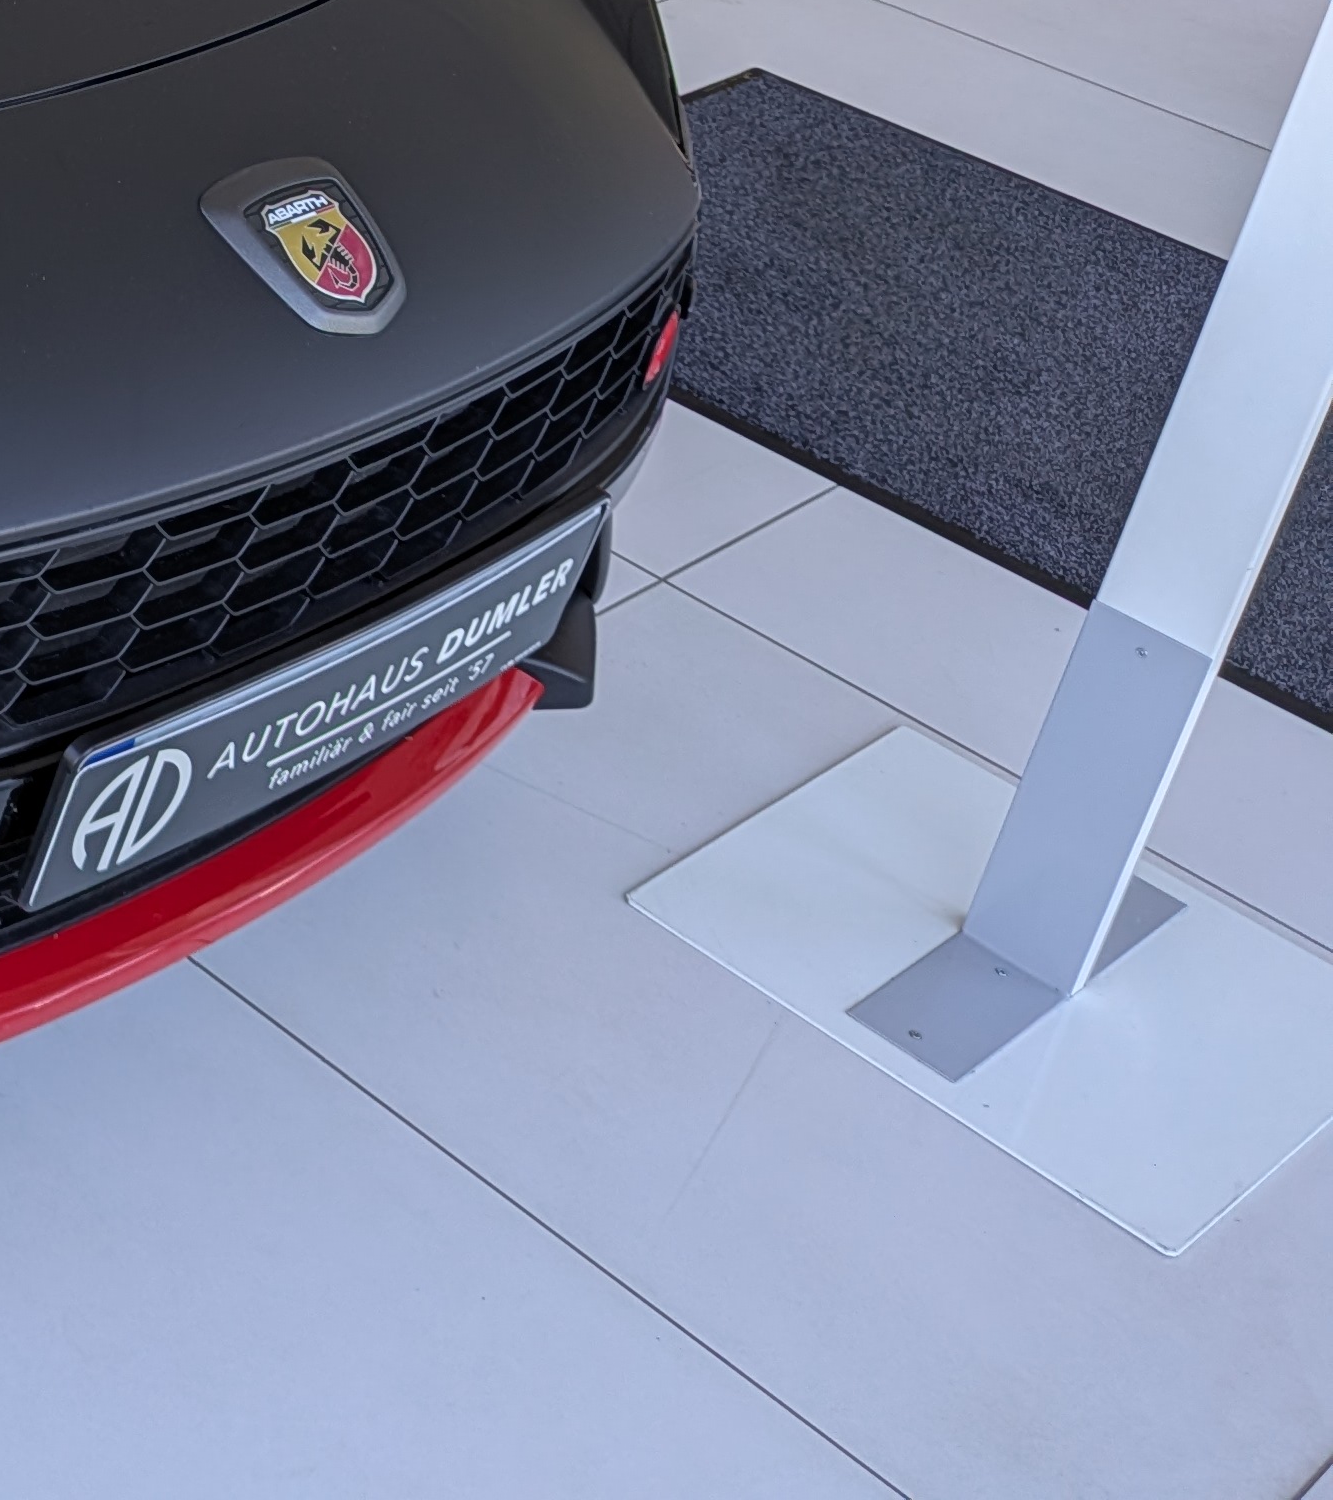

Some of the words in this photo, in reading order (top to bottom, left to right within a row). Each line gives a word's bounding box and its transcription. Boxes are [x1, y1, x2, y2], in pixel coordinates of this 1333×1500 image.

[268, 196, 329, 225] ABARTH
[207, 646, 430, 779] AUTOHAUS
[436, 558, 575, 665] DUMLER
[268, 736, 353, 790] familiär
[358, 722, 375, 744] &
[381, 701, 418, 732] fair
[421, 676, 461, 710] seit
[72, 748, 193, 872] AD
